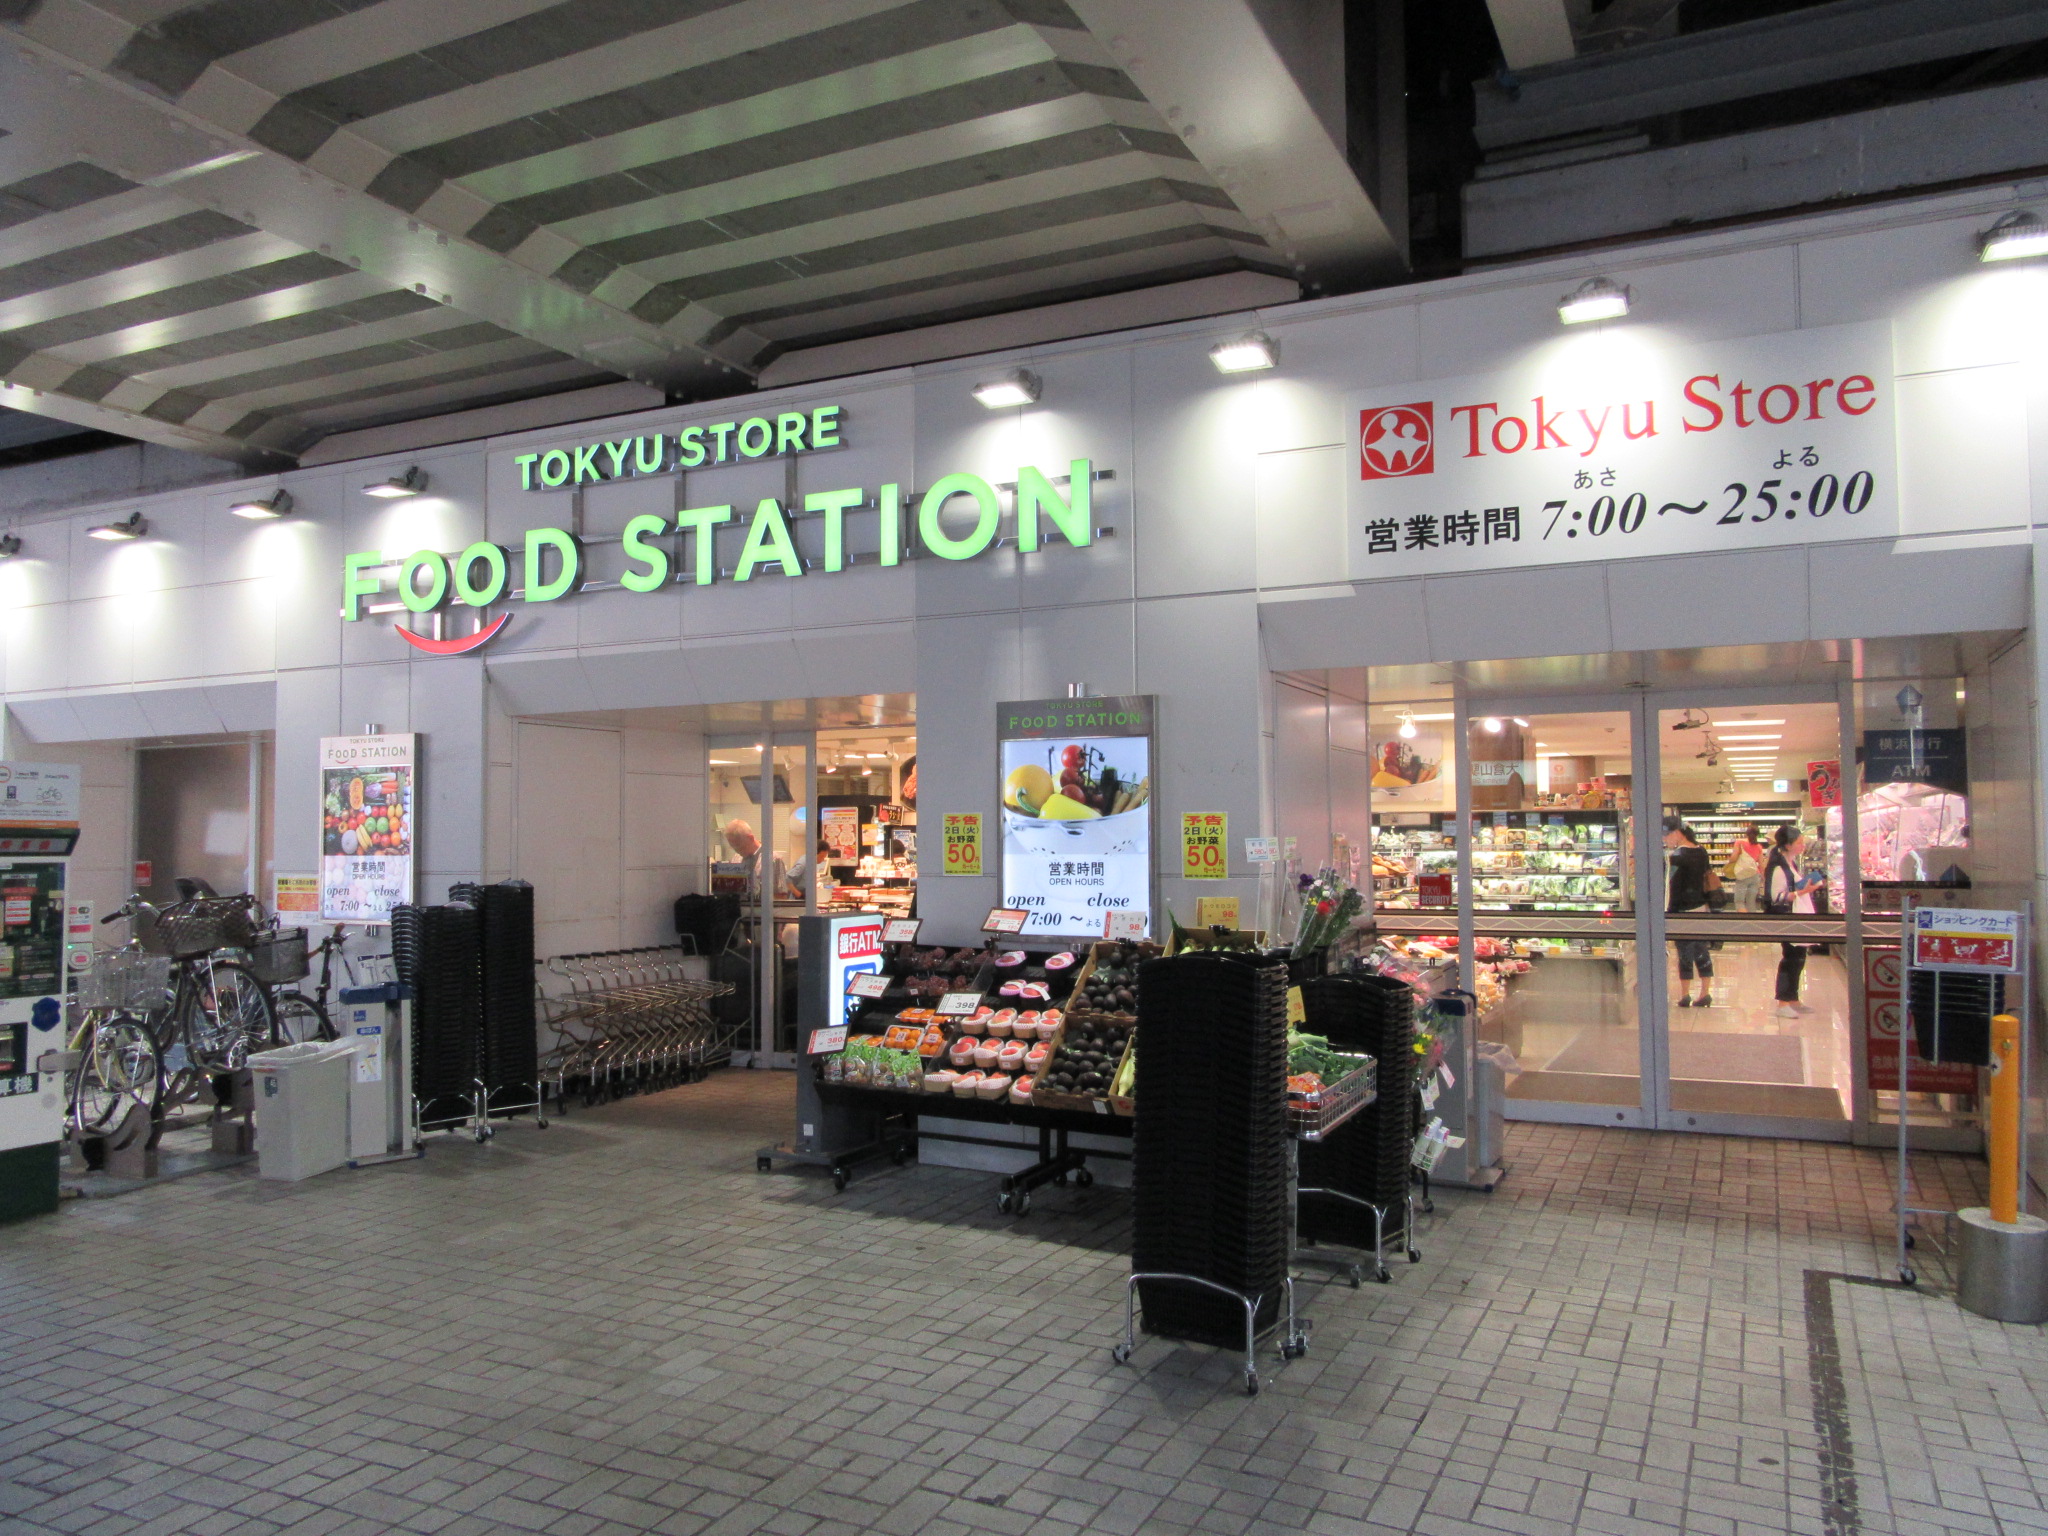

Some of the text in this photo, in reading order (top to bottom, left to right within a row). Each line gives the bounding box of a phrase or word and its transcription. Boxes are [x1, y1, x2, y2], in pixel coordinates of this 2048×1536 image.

[1450, 373, 1877, 458] Tokyu Store
[514, 405, 842, 491] TOKYU STORE
[1772, 446, 1821, 470] よる
[1573, 467, 1618, 491] あさ
[1364, 507, 1521, 555] 営業時間
[343, 458, 1093, 622] FOOD STATION
[1009, 712, 1140, 729] FOOD STATION
[328, 746, 407, 759] FOOD STATION
[1891, 764, 1931, 777] ATM
[945, 816, 979, 826] 予告
[1184, 815, 1223, 826] 予告
[947, 835, 976, 844] お野菜
[1186, 836, 1219, 845] お野菜
[352, 861, 386, 873] 営業時間
[1049, 861, 1105, 876] 営業時間
[1049, 878, 1105, 886] OPEN HOURS
[326, 885, 400, 898] open close
[1421, 886, 1441, 895] TOKYU
[340, 900, 360, 911] 7:00
[1007, 893, 1130, 908] open close
[1421, 895, 1450, 904] SECURITY
[1030, 912, 1062, 926] 7:00
[1086, 918, 1101, 927] よる
